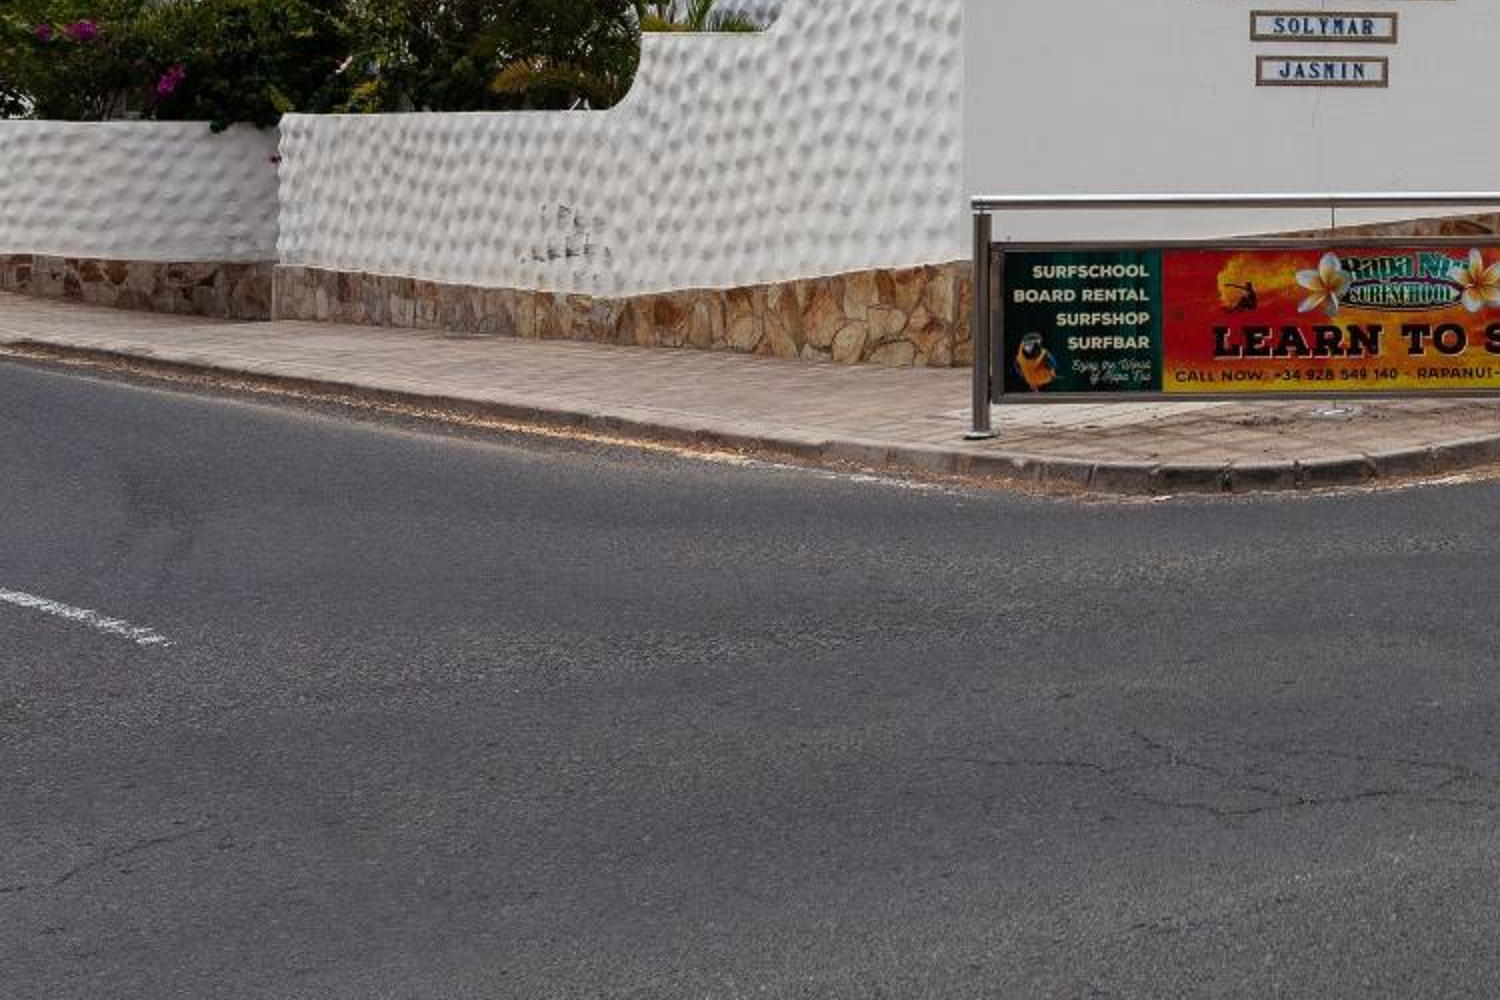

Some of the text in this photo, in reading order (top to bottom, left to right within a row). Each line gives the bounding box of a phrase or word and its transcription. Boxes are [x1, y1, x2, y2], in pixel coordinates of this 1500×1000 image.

[1273, 18, 1374, 36] SOLYMAR
[1279, 62, 1366, 79] JASMIN
[1032, 264, 1150, 279] SURFSCHOOL
[1013, 288, 1150, 303] BOARD RENTAL
[1056, 312, 1150, 327] SURFSHOP
[1067, 336, 1150, 350] SURFBAR
[1213, 324, 1385, 360] LEARN
[1401, 323, 1470, 357] TO
[1175, 369, 1214, 382] CALL
[1374, 367, 1398, 380] 140
